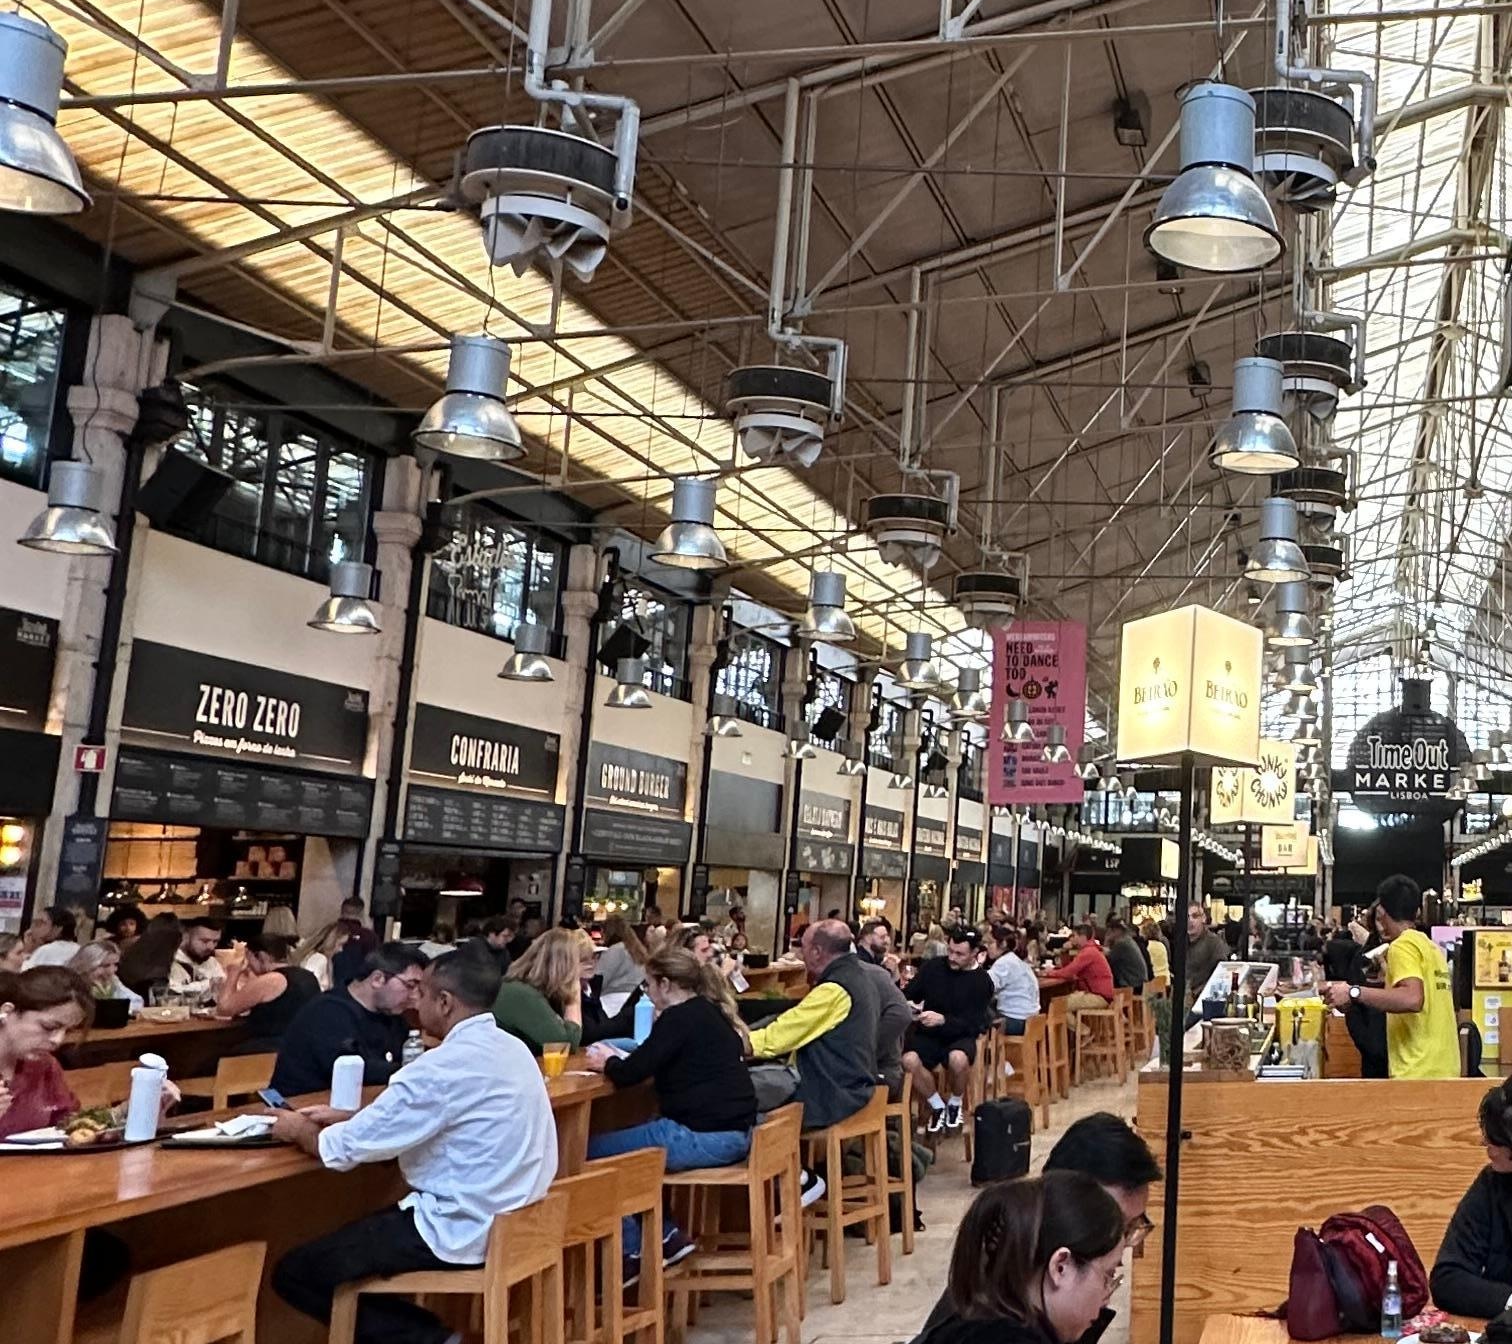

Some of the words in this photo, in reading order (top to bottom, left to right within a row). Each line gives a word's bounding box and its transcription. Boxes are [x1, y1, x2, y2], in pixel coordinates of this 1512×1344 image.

[1006, 641, 1033, 654] NEED
[1006, 654, 1019, 667] TO
[1023, 654, 1059, 667] DANCE
[1005, 668, 1027, 680] TOO
[195, 684, 248, 729] ZERO
[253, 695, 300, 739] ZERO
[450, 734, 520, 775] CONFRARIA
[1367, 736, 1412, 769] Time
[1413, 738, 1449, 771] Out
[1355, 772, 1446, 789] MARKE
[1390, 791, 1429, 800] LISBOA
